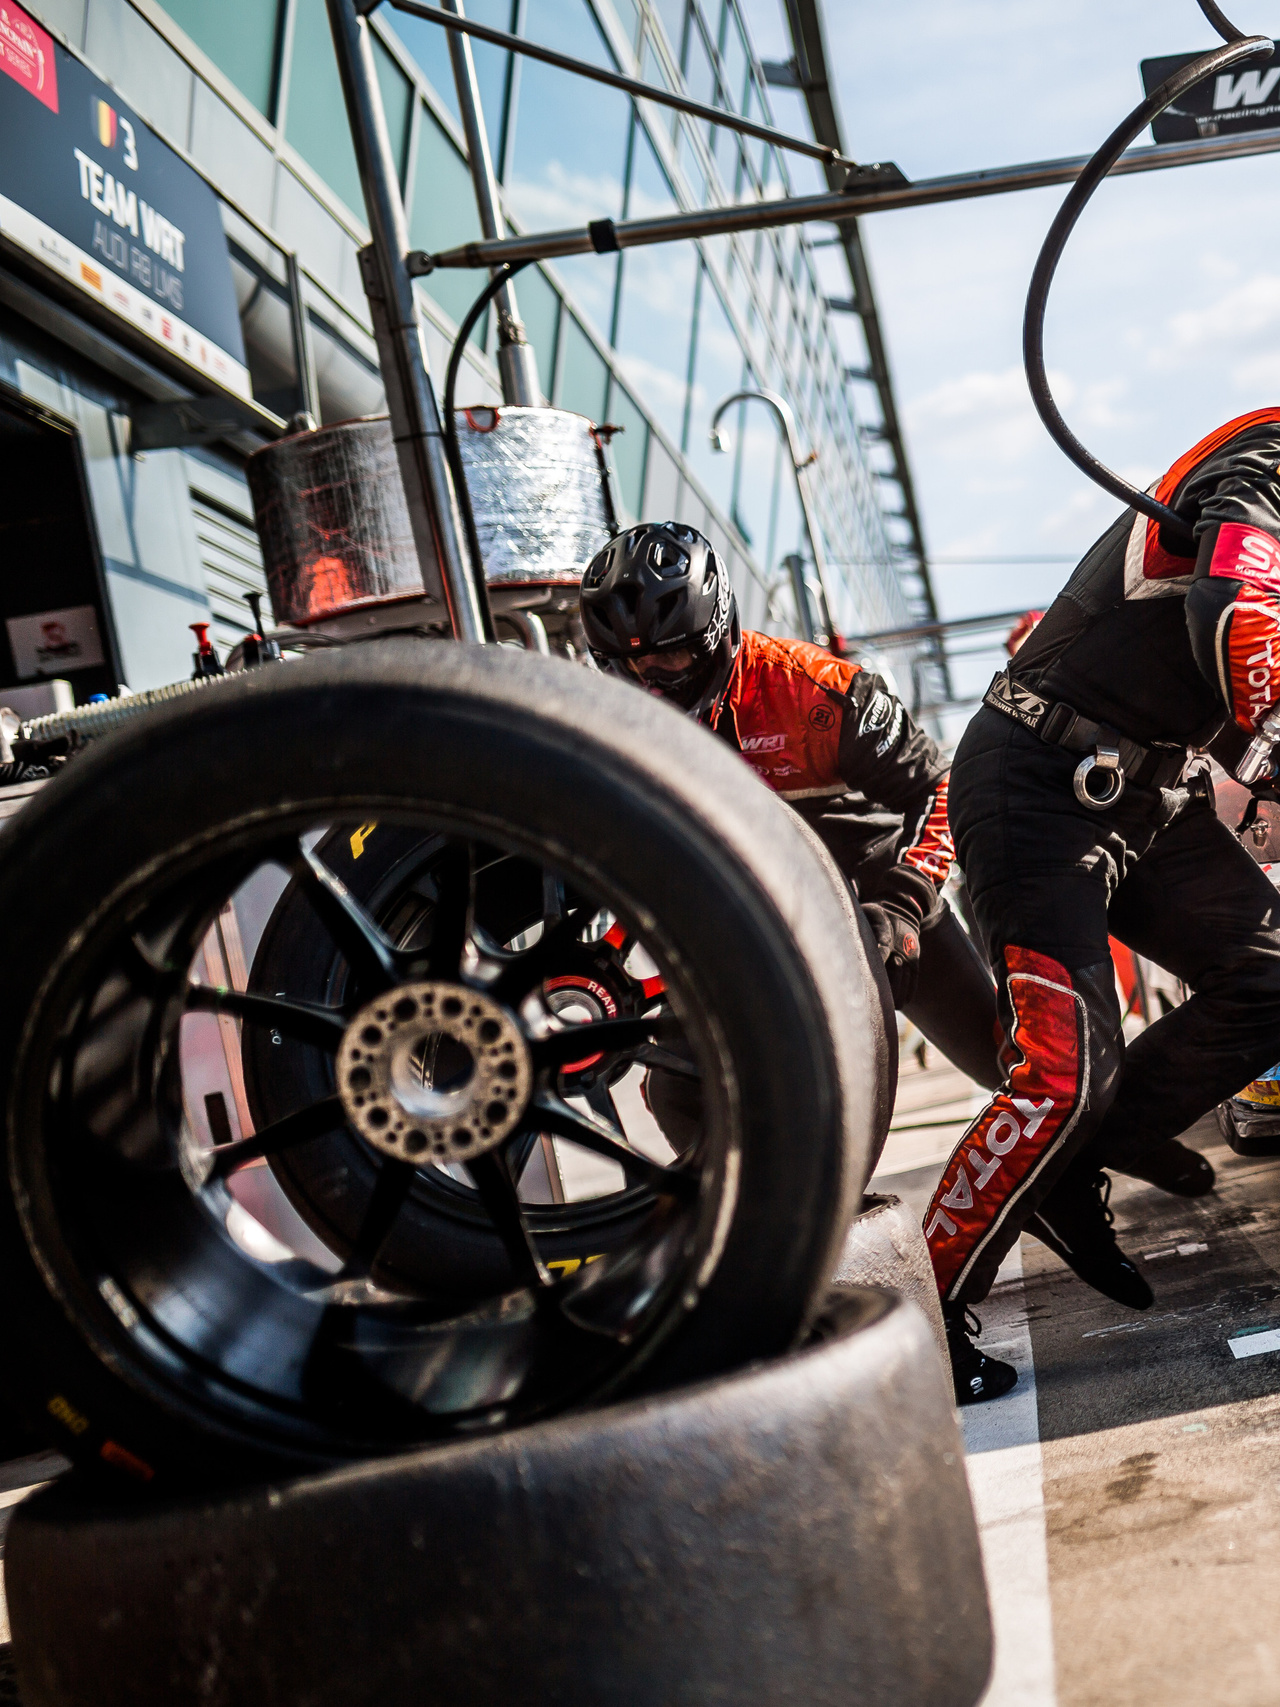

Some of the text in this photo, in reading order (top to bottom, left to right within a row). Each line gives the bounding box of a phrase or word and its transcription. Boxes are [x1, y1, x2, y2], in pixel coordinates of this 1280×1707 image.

[119, 115, 139, 172] 3
[73, 147, 186, 273] TEAM WRT
[91, 218, 129, 273] AUDI
[1245, 639, 1276, 732] TOTA
[742, 734, 788, 750] WRT
[813, 711, 831, 725] 21
[587, 980, 617, 1015] REAR
[925, 1097, 1055, 1240] TOTAL
